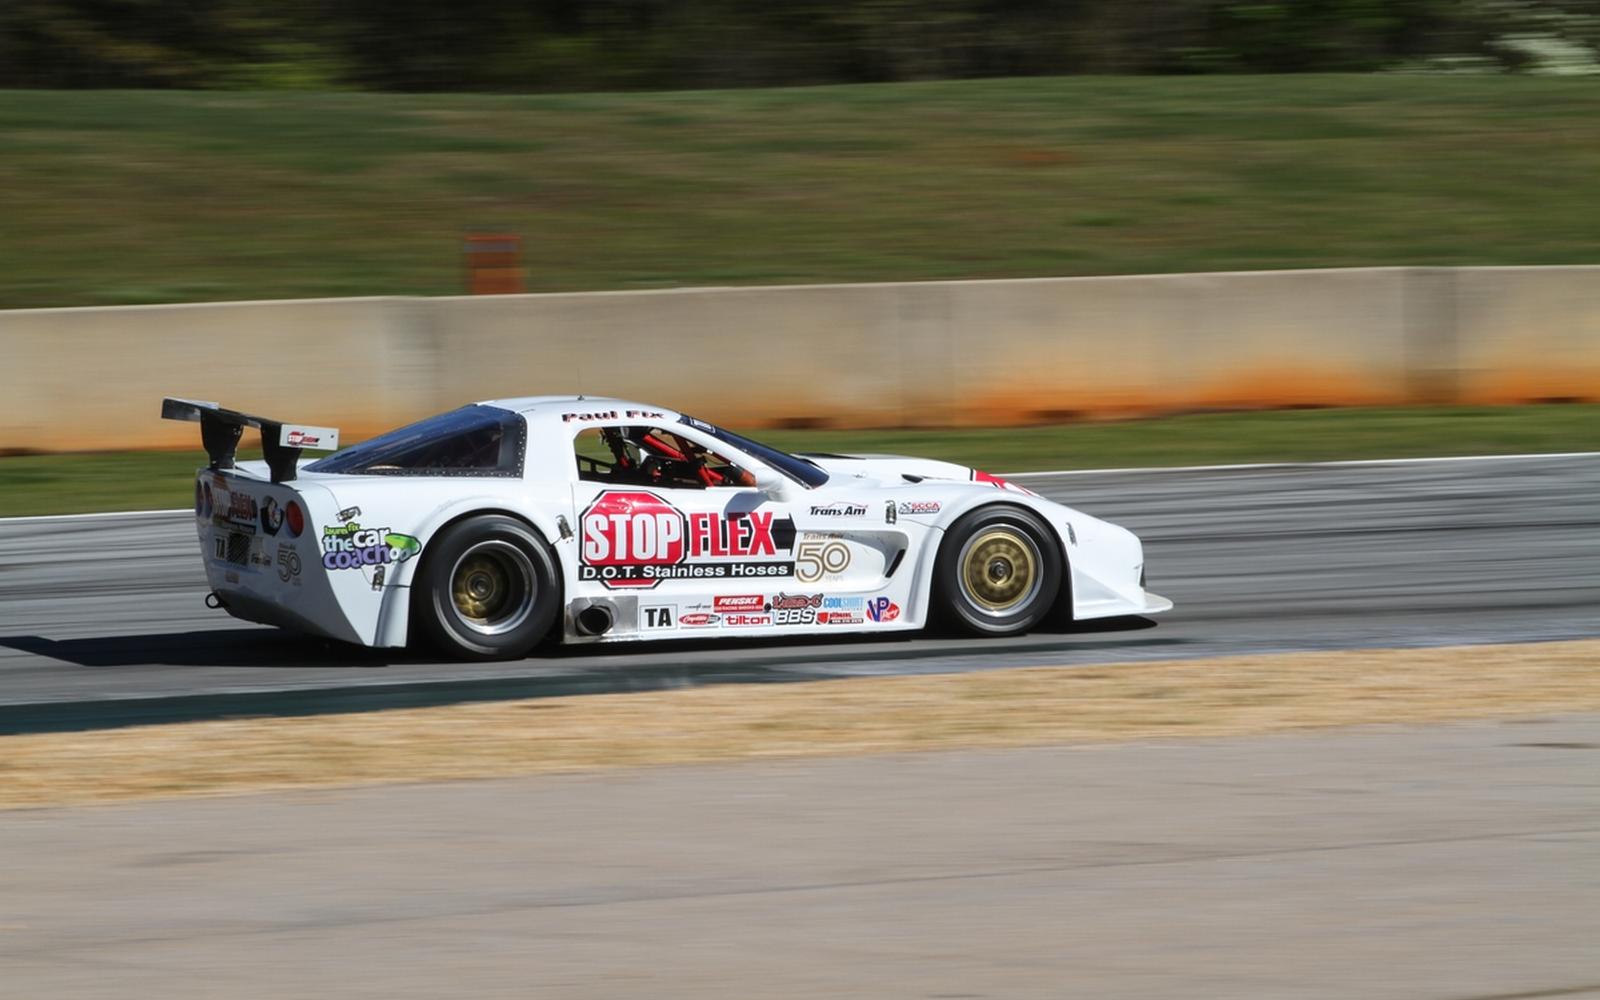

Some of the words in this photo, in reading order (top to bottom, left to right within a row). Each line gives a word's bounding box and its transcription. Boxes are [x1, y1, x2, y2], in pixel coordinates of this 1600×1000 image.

[562, 410, 618, 422] Paul
[626, 410, 664, 420] Fix
[810, 505, 842, 515] Trans
[843, 505, 866, 515] Am
[323, 536, 354, 552] the
[352, 528, 391, 548] car
[585, 513, 681, 560] STOP
[690, 512, 776, 557] FLEX
[323, 545, 392, 569] coach
[796, 542, 850, 583] 50
[583, 566, 637, 579] D.O.T.
[642, 564, 724, 578] Stainless
[731, 563, 788, 576] Hoses
[644, 608, 672, 627] TA
[725, 615, 771, 625] tilton
[776, 608, 815, 626] BBS
[867, 597, 890, 622] VP
